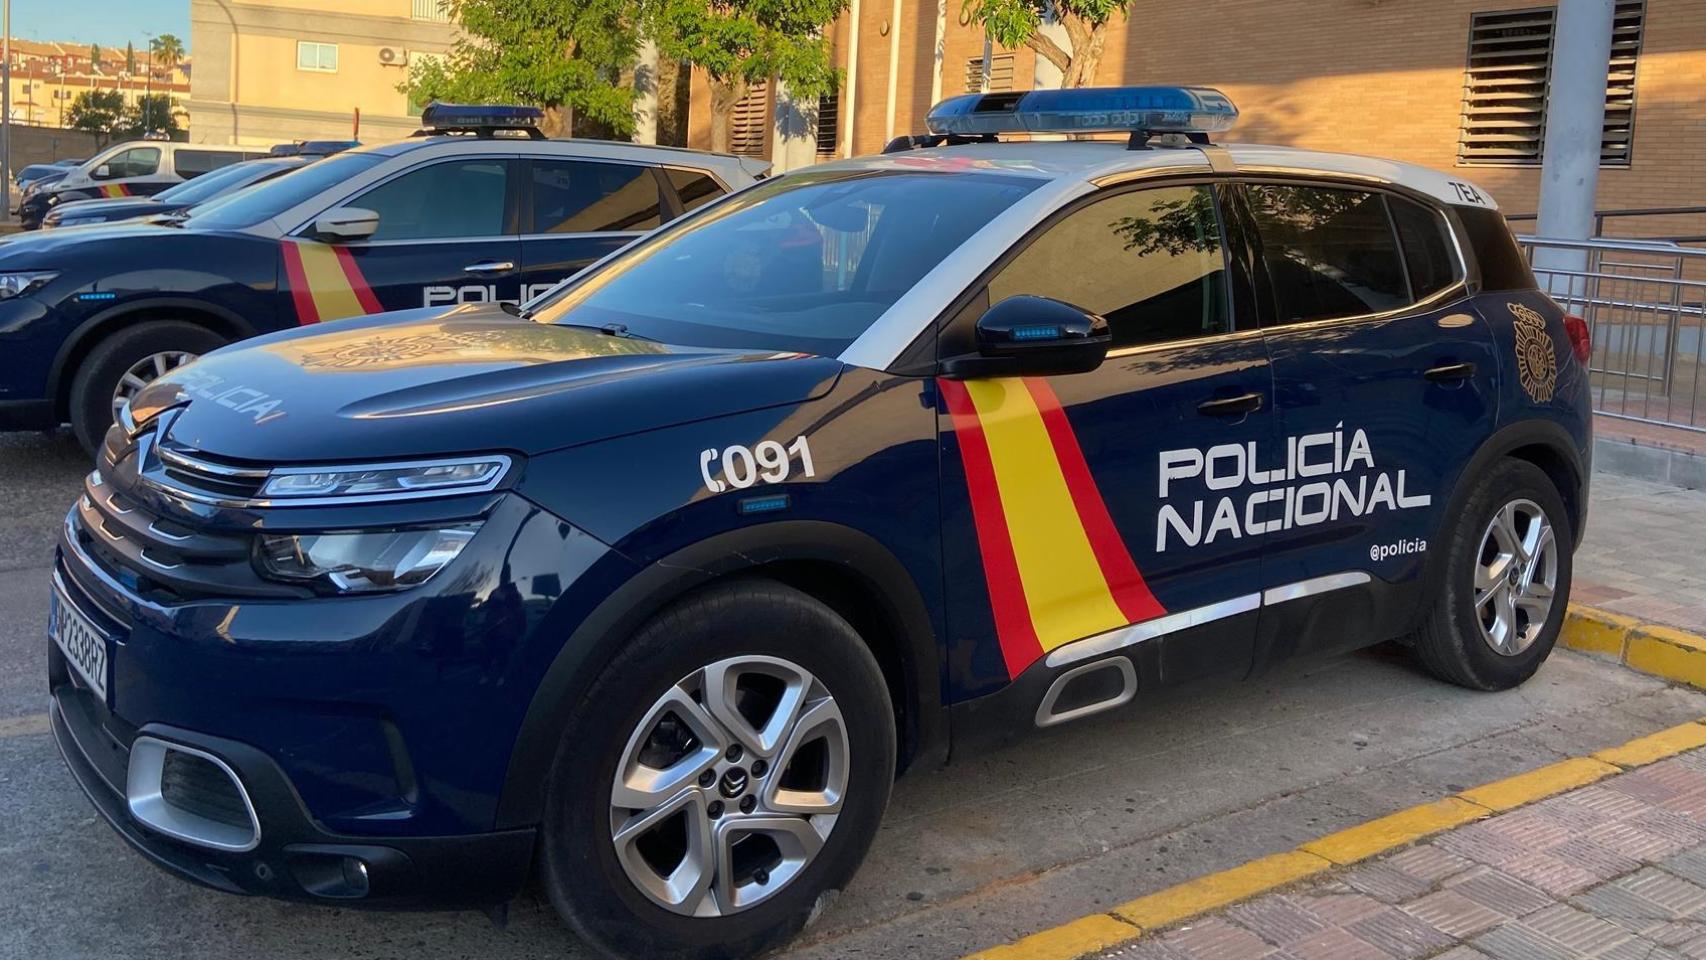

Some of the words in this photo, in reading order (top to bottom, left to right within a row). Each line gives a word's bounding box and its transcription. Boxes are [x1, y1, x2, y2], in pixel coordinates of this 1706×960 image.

[722, 435, 815, 489] 091
[1159, 421, 1375, 498] POLICÍA
[1156, 470, 1431, 552] NACIONAL
[1370, 537, 1427, 561] @policia
